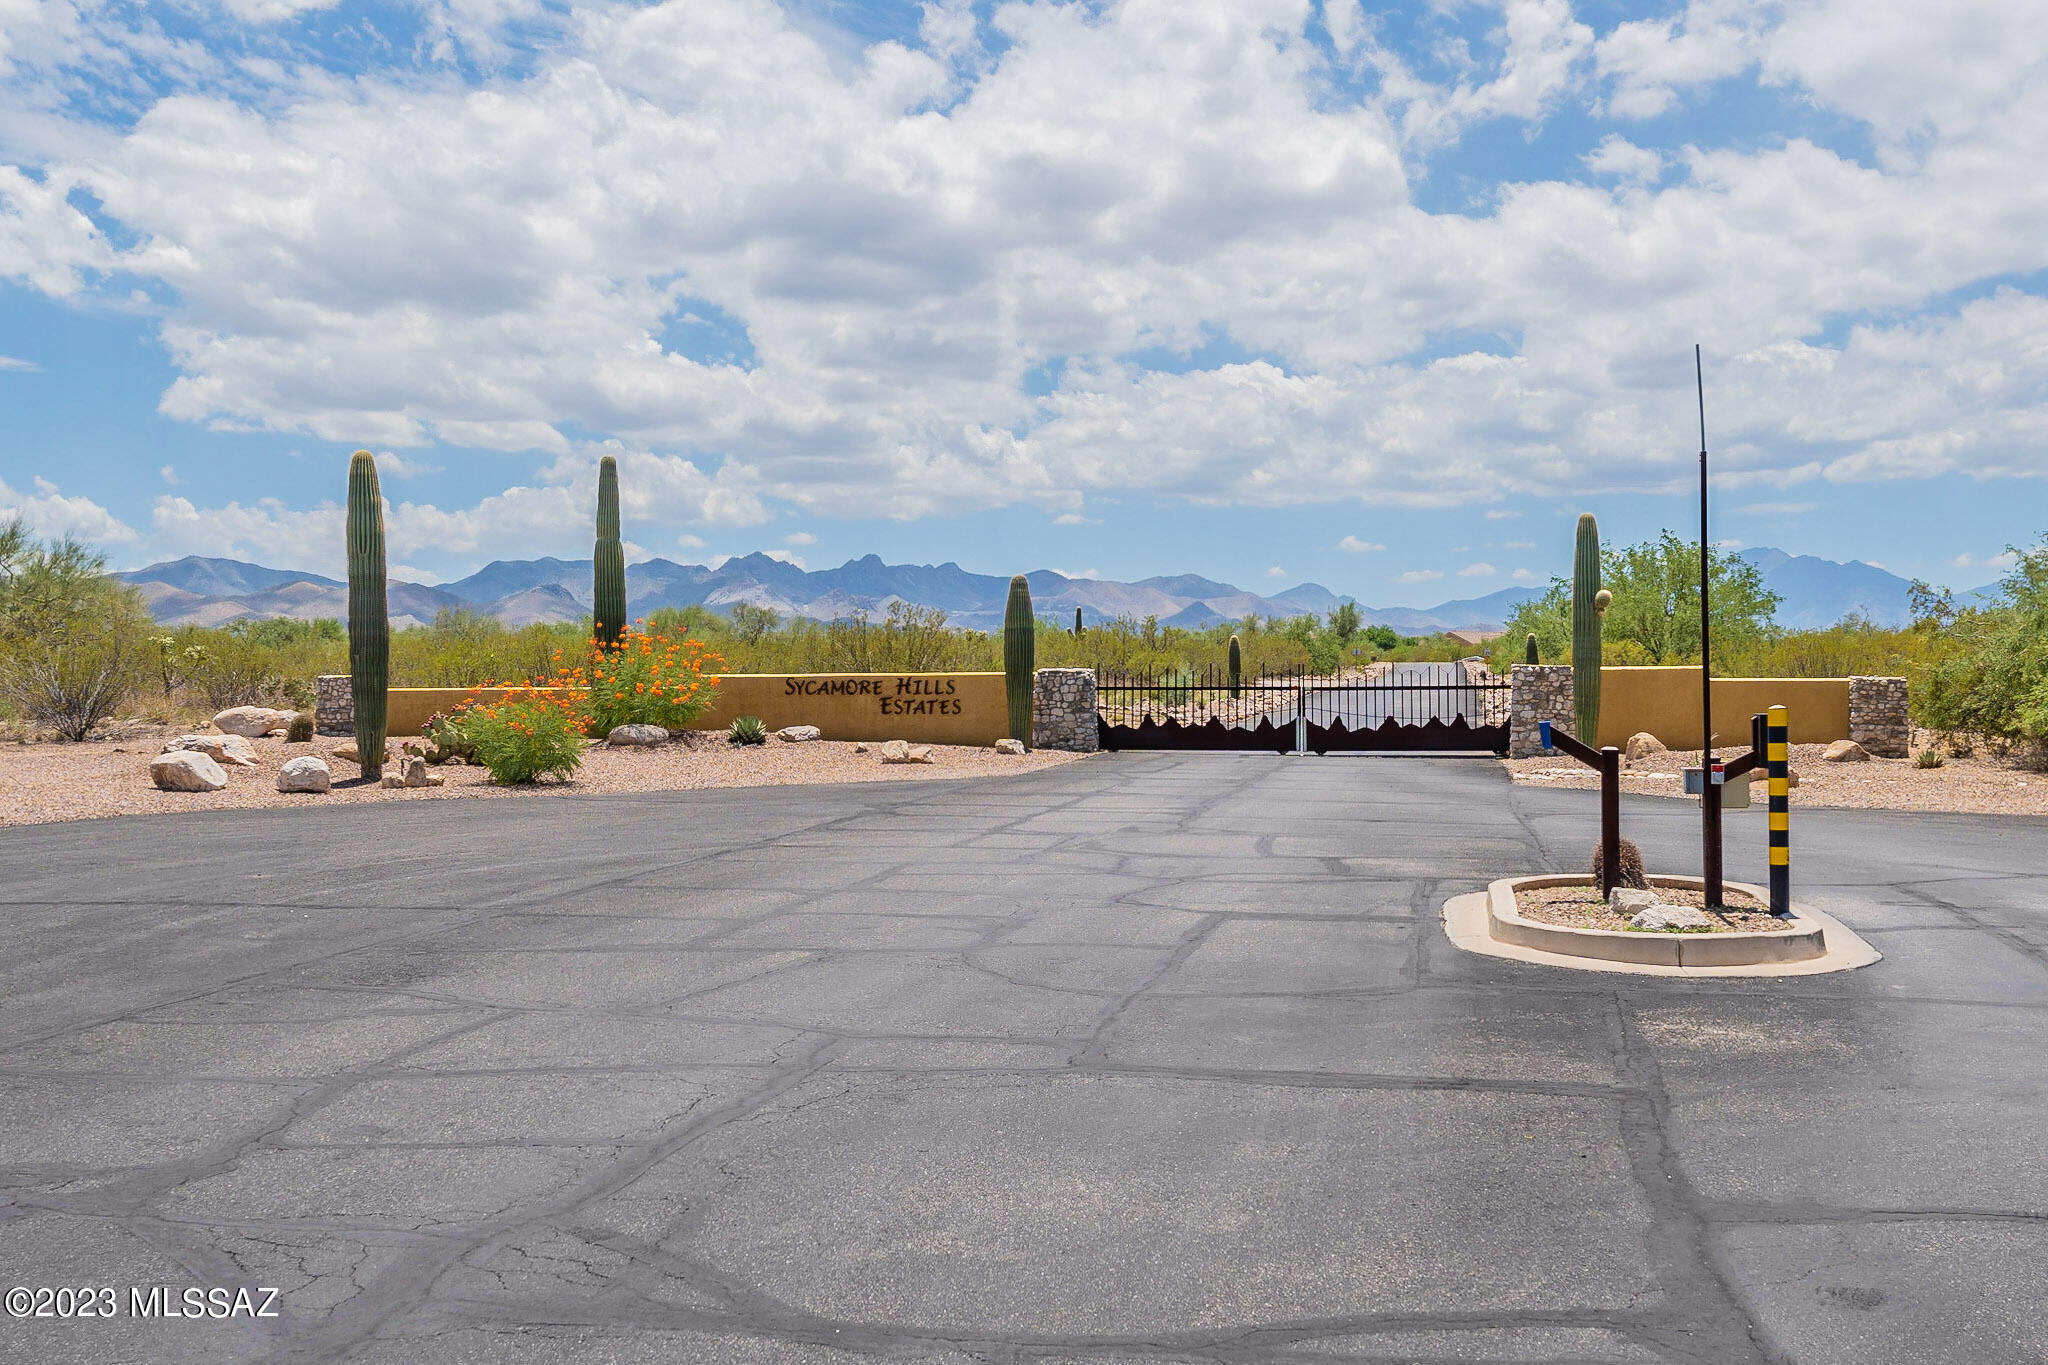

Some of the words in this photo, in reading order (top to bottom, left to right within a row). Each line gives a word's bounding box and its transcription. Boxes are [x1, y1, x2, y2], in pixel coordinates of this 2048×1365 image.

[785, 677, 883, 695] SYCAMORE
[896, 677, 956, 695] HILLS
[879, 696, 962, 715] ESTATES
